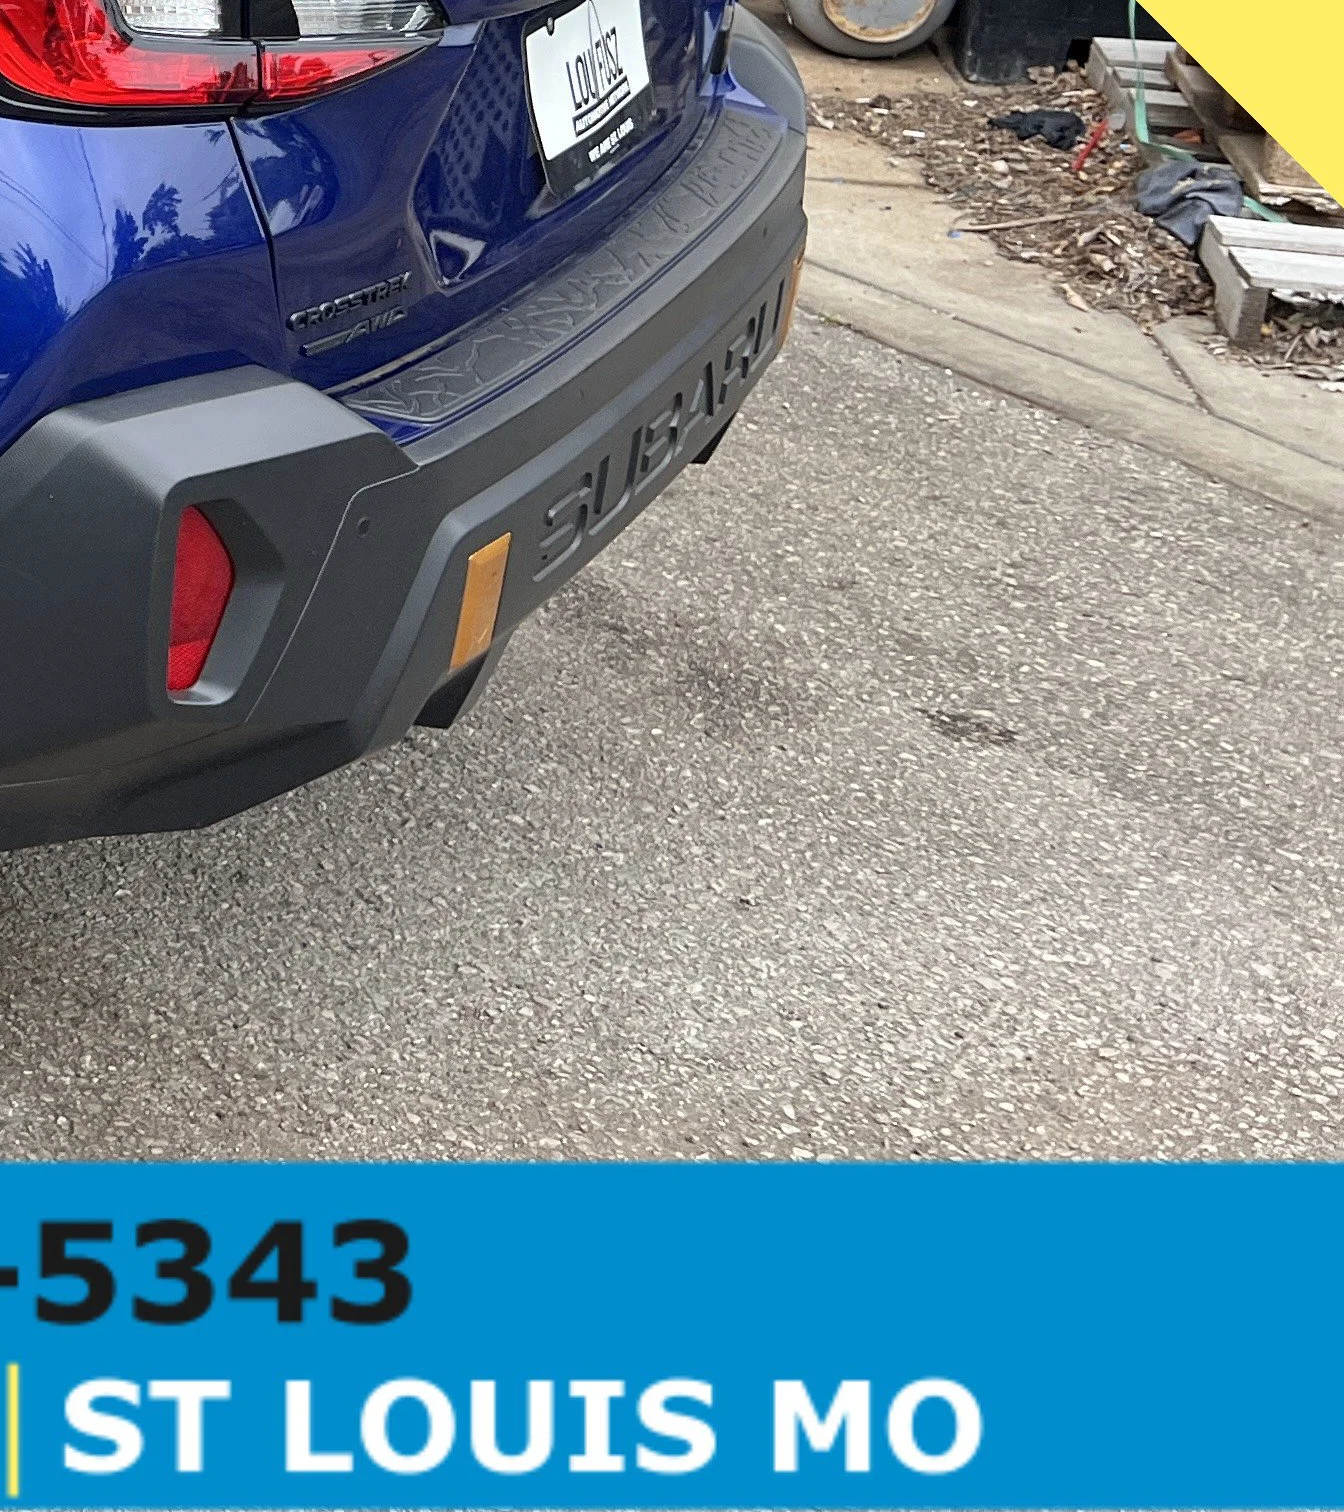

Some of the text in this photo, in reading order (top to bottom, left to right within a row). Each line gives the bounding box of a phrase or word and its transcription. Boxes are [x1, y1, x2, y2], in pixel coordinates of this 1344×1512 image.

[565, 48, 598, 111] LOU
[595, 26, 624, 91] FUSZ
[286, 270, 411, 331] CROSSTREK
[532, 277, 786, 583] SUBARU
